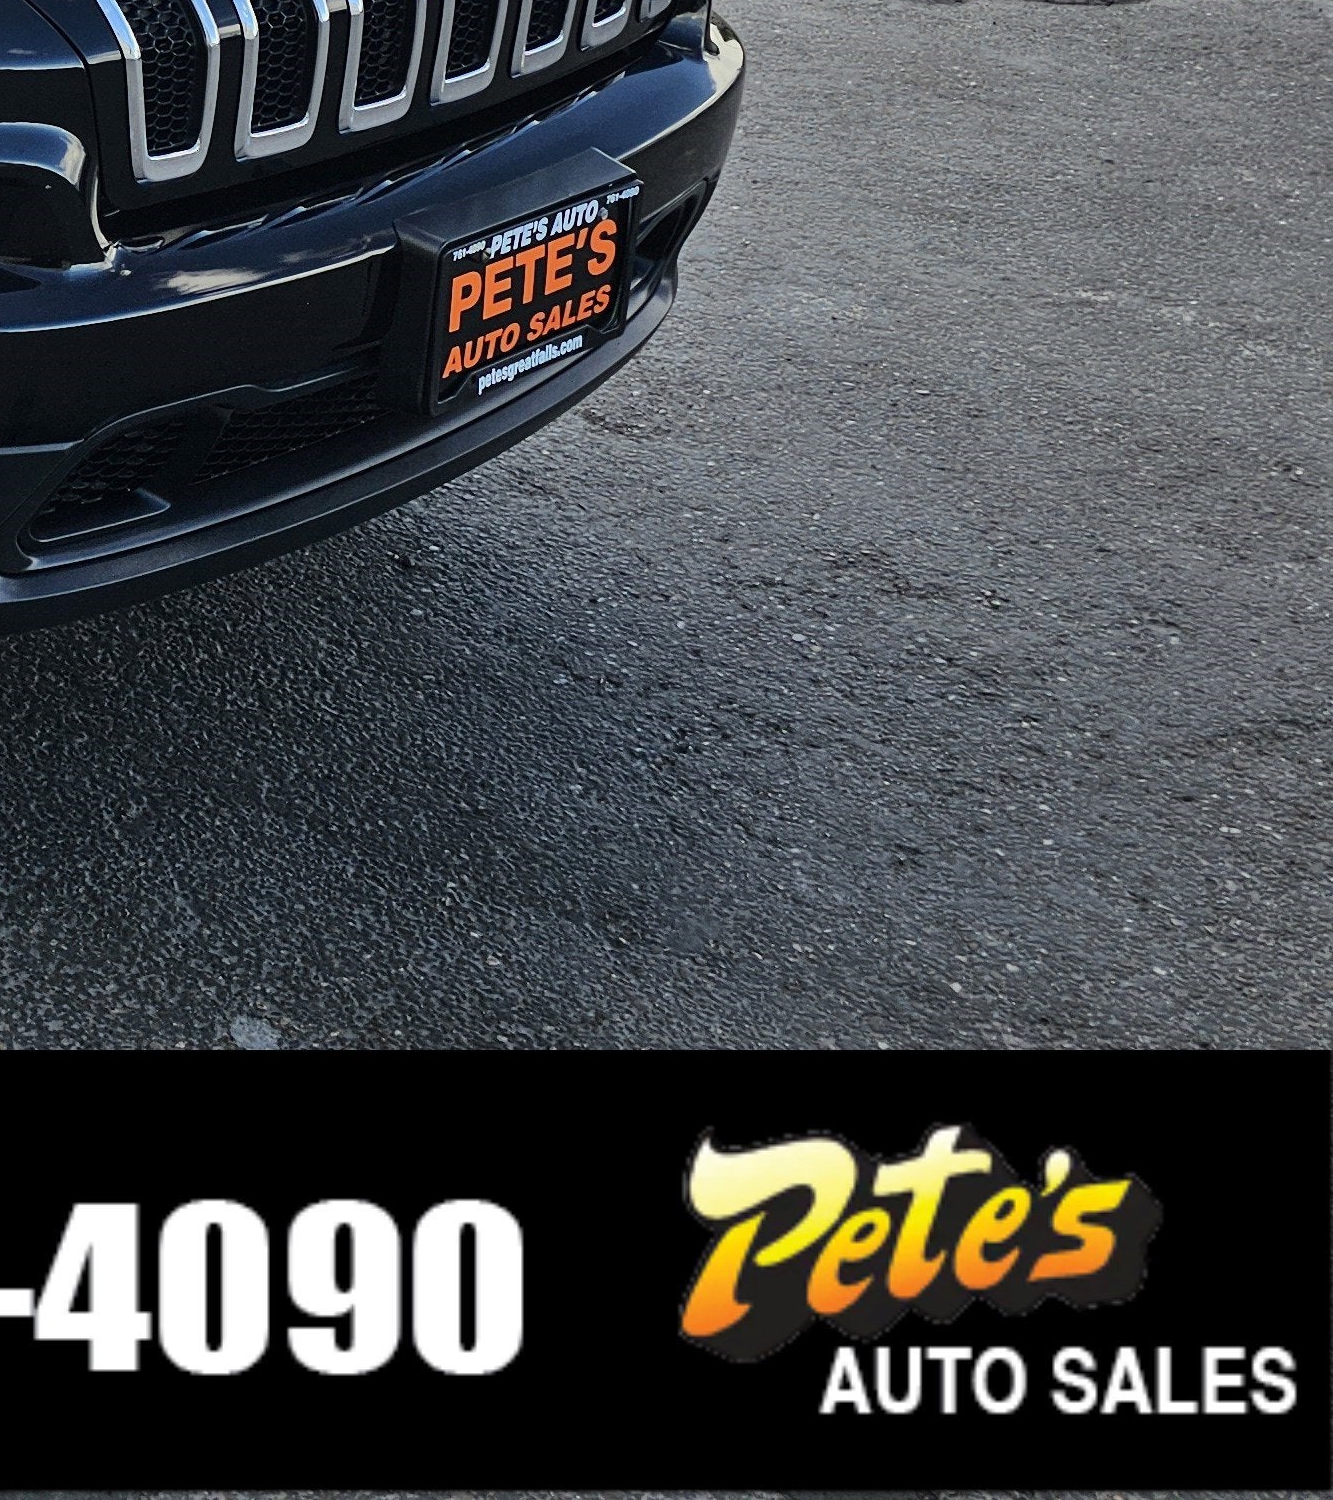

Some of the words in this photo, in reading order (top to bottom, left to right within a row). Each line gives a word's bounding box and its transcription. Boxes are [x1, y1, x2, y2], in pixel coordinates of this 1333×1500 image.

[489, 216, 549, 259] PETE'S
[550, 199, 599, 236] AUTO
[449, 219, 617, 333] PETE'S
[442, 322, 520, 379] AUTO
[526, 284, 612, 342] SALES
[477, 334, 583, 396] petesgreatfalls.com
